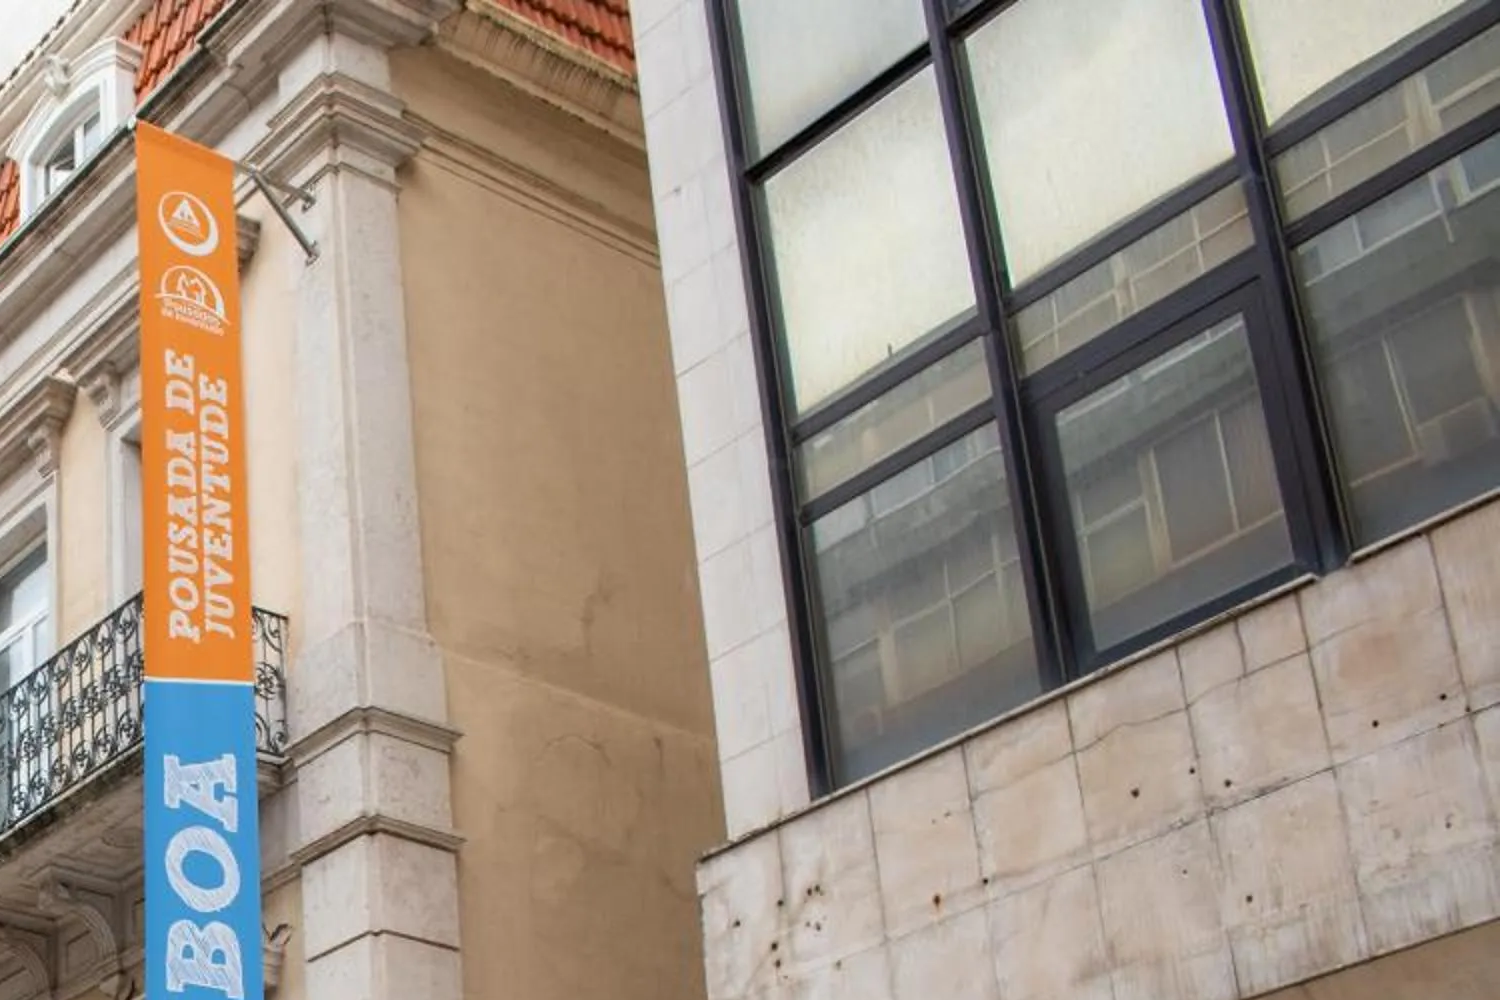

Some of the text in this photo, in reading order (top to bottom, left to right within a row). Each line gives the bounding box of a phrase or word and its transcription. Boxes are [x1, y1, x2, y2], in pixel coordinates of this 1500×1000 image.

[164, 348, 201, 644] POUSADA DE
[199, 371, 235, 640] JUVENTUDE
